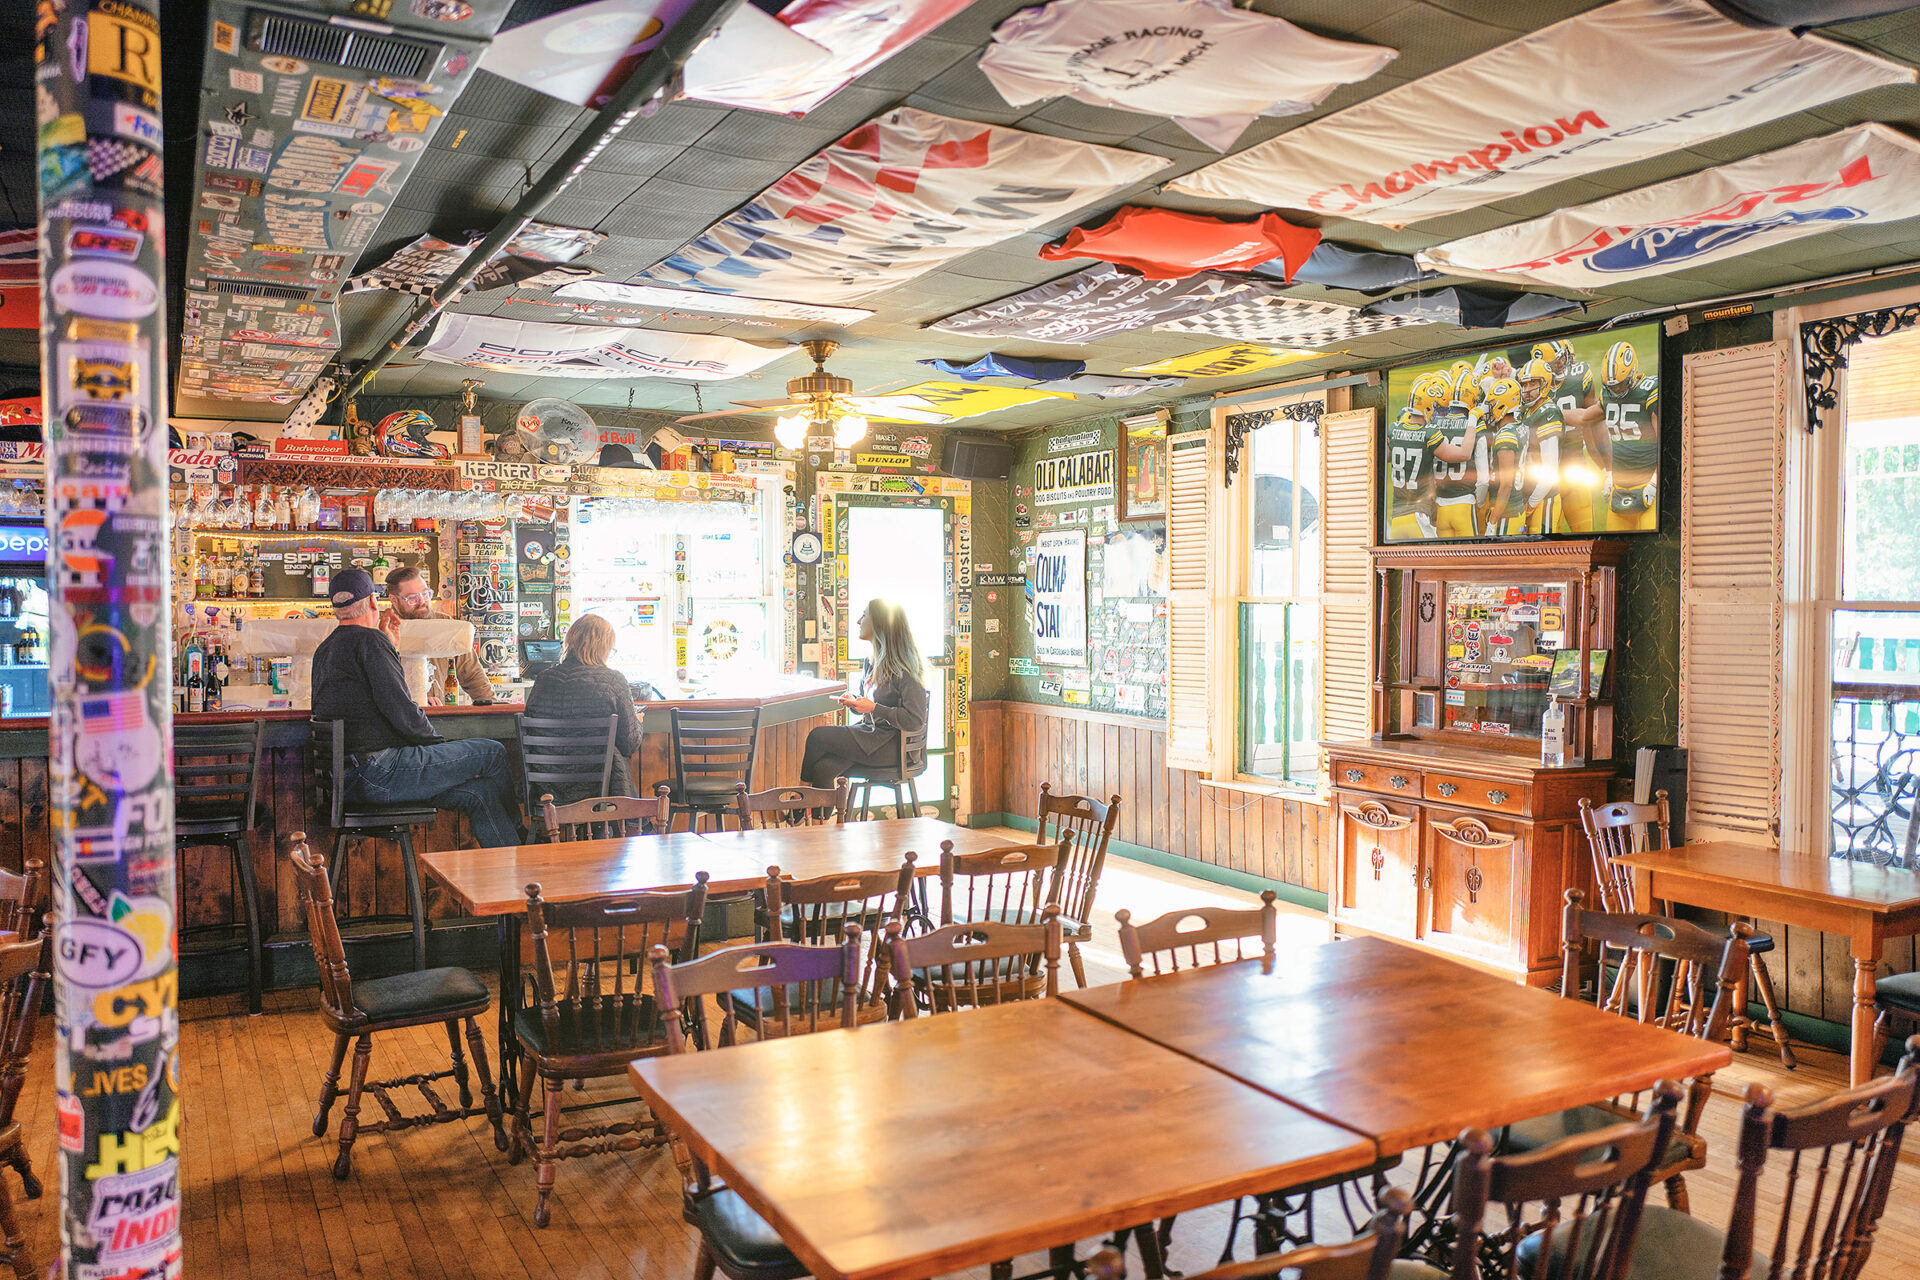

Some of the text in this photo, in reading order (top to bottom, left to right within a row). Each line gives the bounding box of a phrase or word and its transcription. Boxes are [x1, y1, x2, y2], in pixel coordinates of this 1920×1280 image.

[1124, 26, 1204, 40] RACING
[110, 22, 156, 84] R
[270, 78, 301, 117] DINAN
[205, 134, 231, 168] sparco
[1307, 110, 1609, 213] Champion
[1703, 304, 1753, 319] mountune
[1606, 403, 1642, 441] 85
[611, 432, 635, 445] Bull
[1391, 429, 1427, 442] STERNBERGER
[284, 444, 343, 454] Budweiser
[465, 462, 530, 479] KERKER
[571, 465, 599, 474] DAVID
[1036, 453, 1110, 491] OLD CALABAR
[1391, 446, 1423, 490] 87
[1046, 491, 1067, 501] BISCUITS
[1074, 487, 1096, 498] POULTRY
[1097, 486, 1112, 496] FOOD
[980, 575, 1006, 585] KMW
[495, 613, 514, 624] Ford
[1543, 608, 1560, 627] 6
[1011, 667, 1039, 675] KEEPER
[60, 937, 126, 971] GFY
